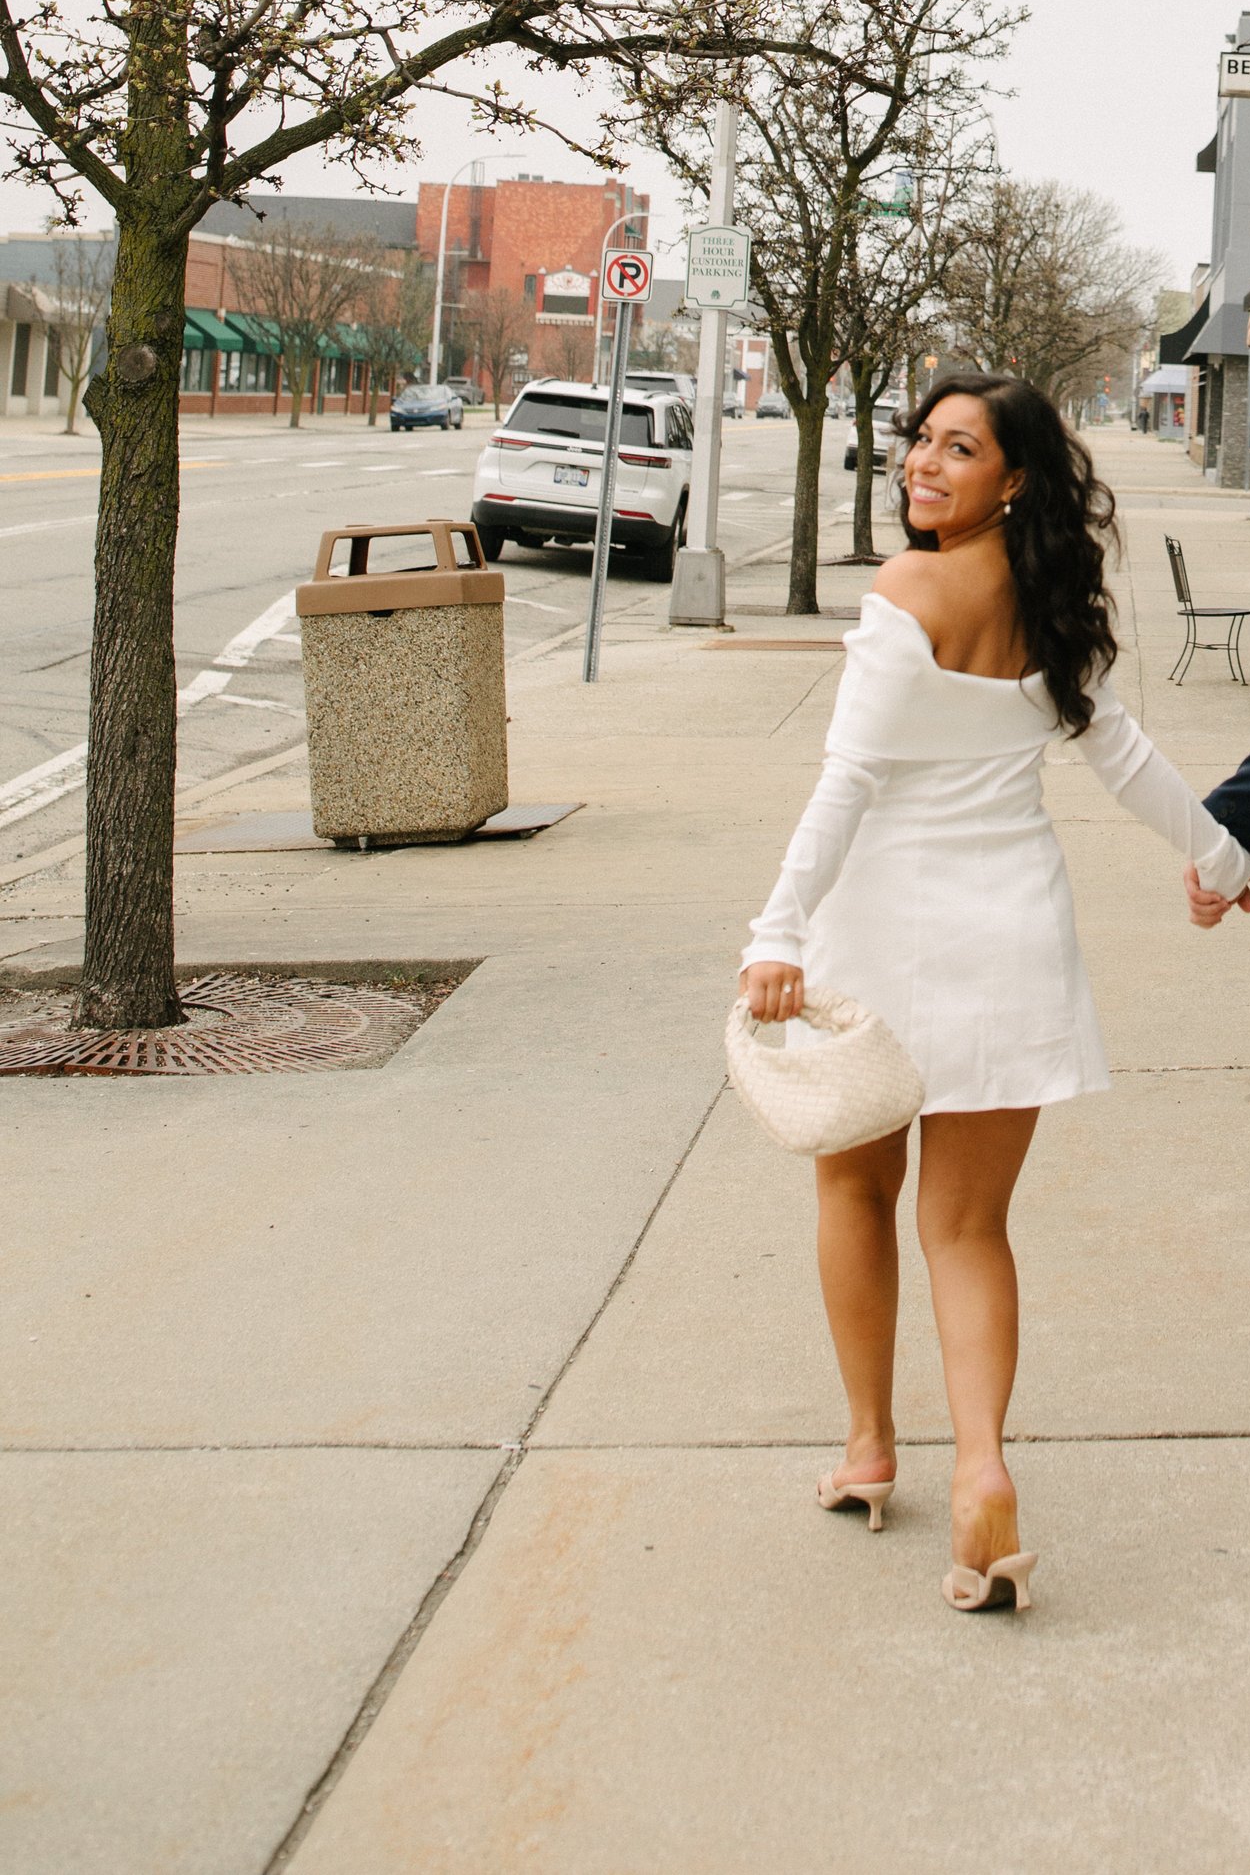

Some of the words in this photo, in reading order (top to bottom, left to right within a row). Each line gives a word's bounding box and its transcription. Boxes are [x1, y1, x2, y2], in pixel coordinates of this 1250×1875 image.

[701, 236, 735, 246] THREE
[702, 247, 735, 257] HOUR
[691, 257, 744, 267] CUSTOMER
[618, 261, 642, 289] P
[691, 268, 742, 277] PARKING
